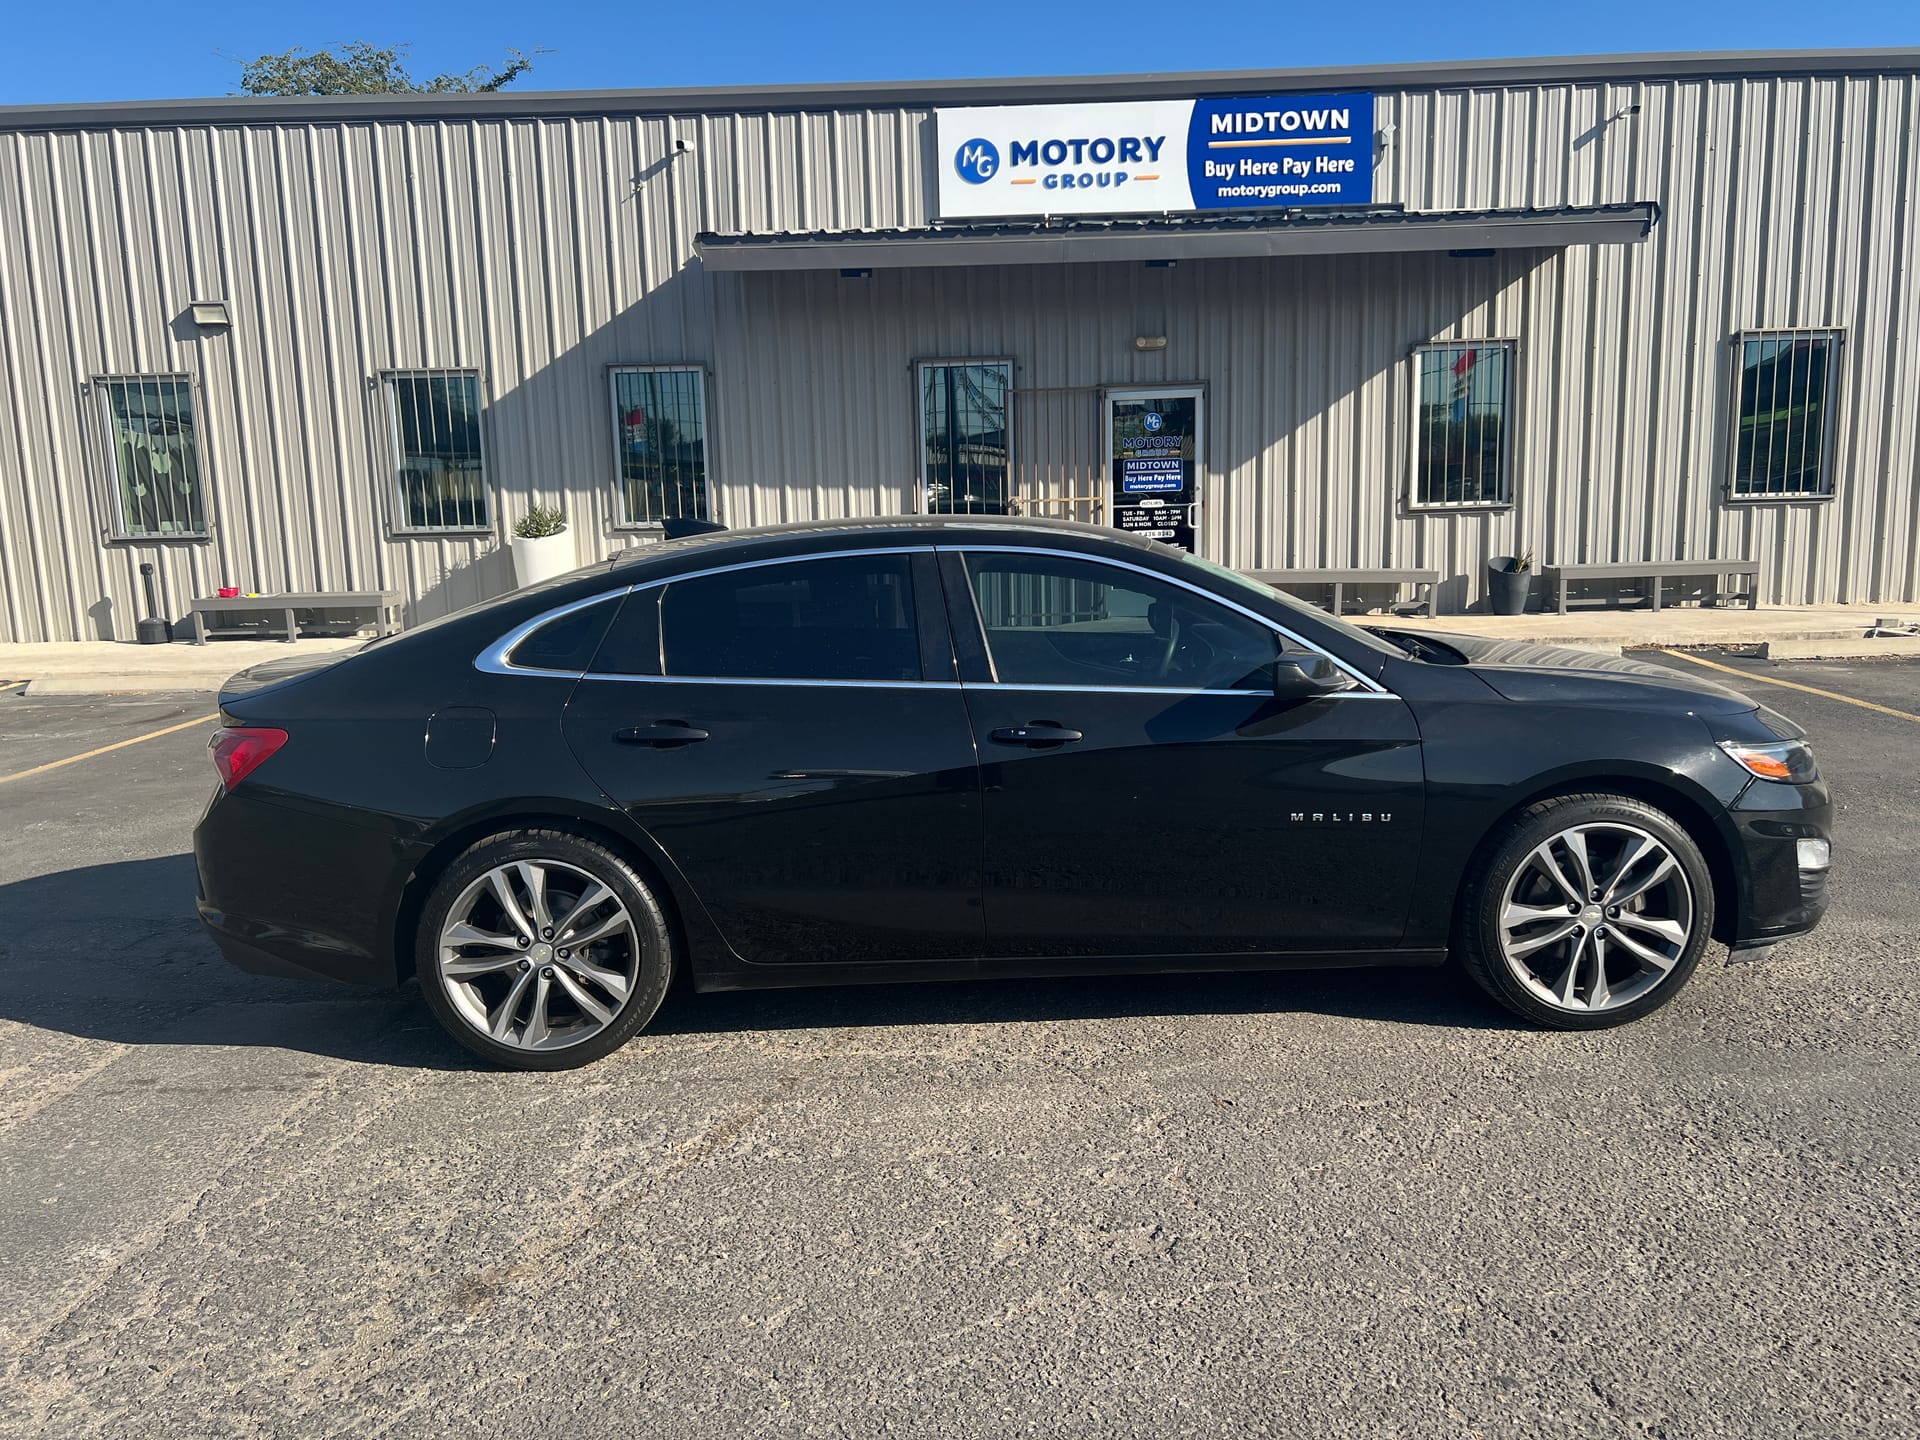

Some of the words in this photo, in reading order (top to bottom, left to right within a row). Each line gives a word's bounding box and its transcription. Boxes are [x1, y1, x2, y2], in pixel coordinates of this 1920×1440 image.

[1211, 109, 1349, 134] MIDTOWN
[1010, 136, 1166, 167] MOTORY
[1205, 160, 1235, 181] Buy
[1240, 159, 1278, 176] Here
[1283, 157, 1311, 178] Pay
[1316, 156, 1355, 173] Here
[1042, 172, 1128, 189] GROUP
[1218, 183, 1341, 197] motorygroup.com
[1123, 436, 1183, 448] MOTORY
[1127, 461, 1179, 470] MIDTOWN
[1125, 475, 1136, 483] Buy
[1154, 474, 1165, 482] Pay
[1291, 813, 1391, 821] MALIBU
[1589, 807, 1646, 821] VIENTO
